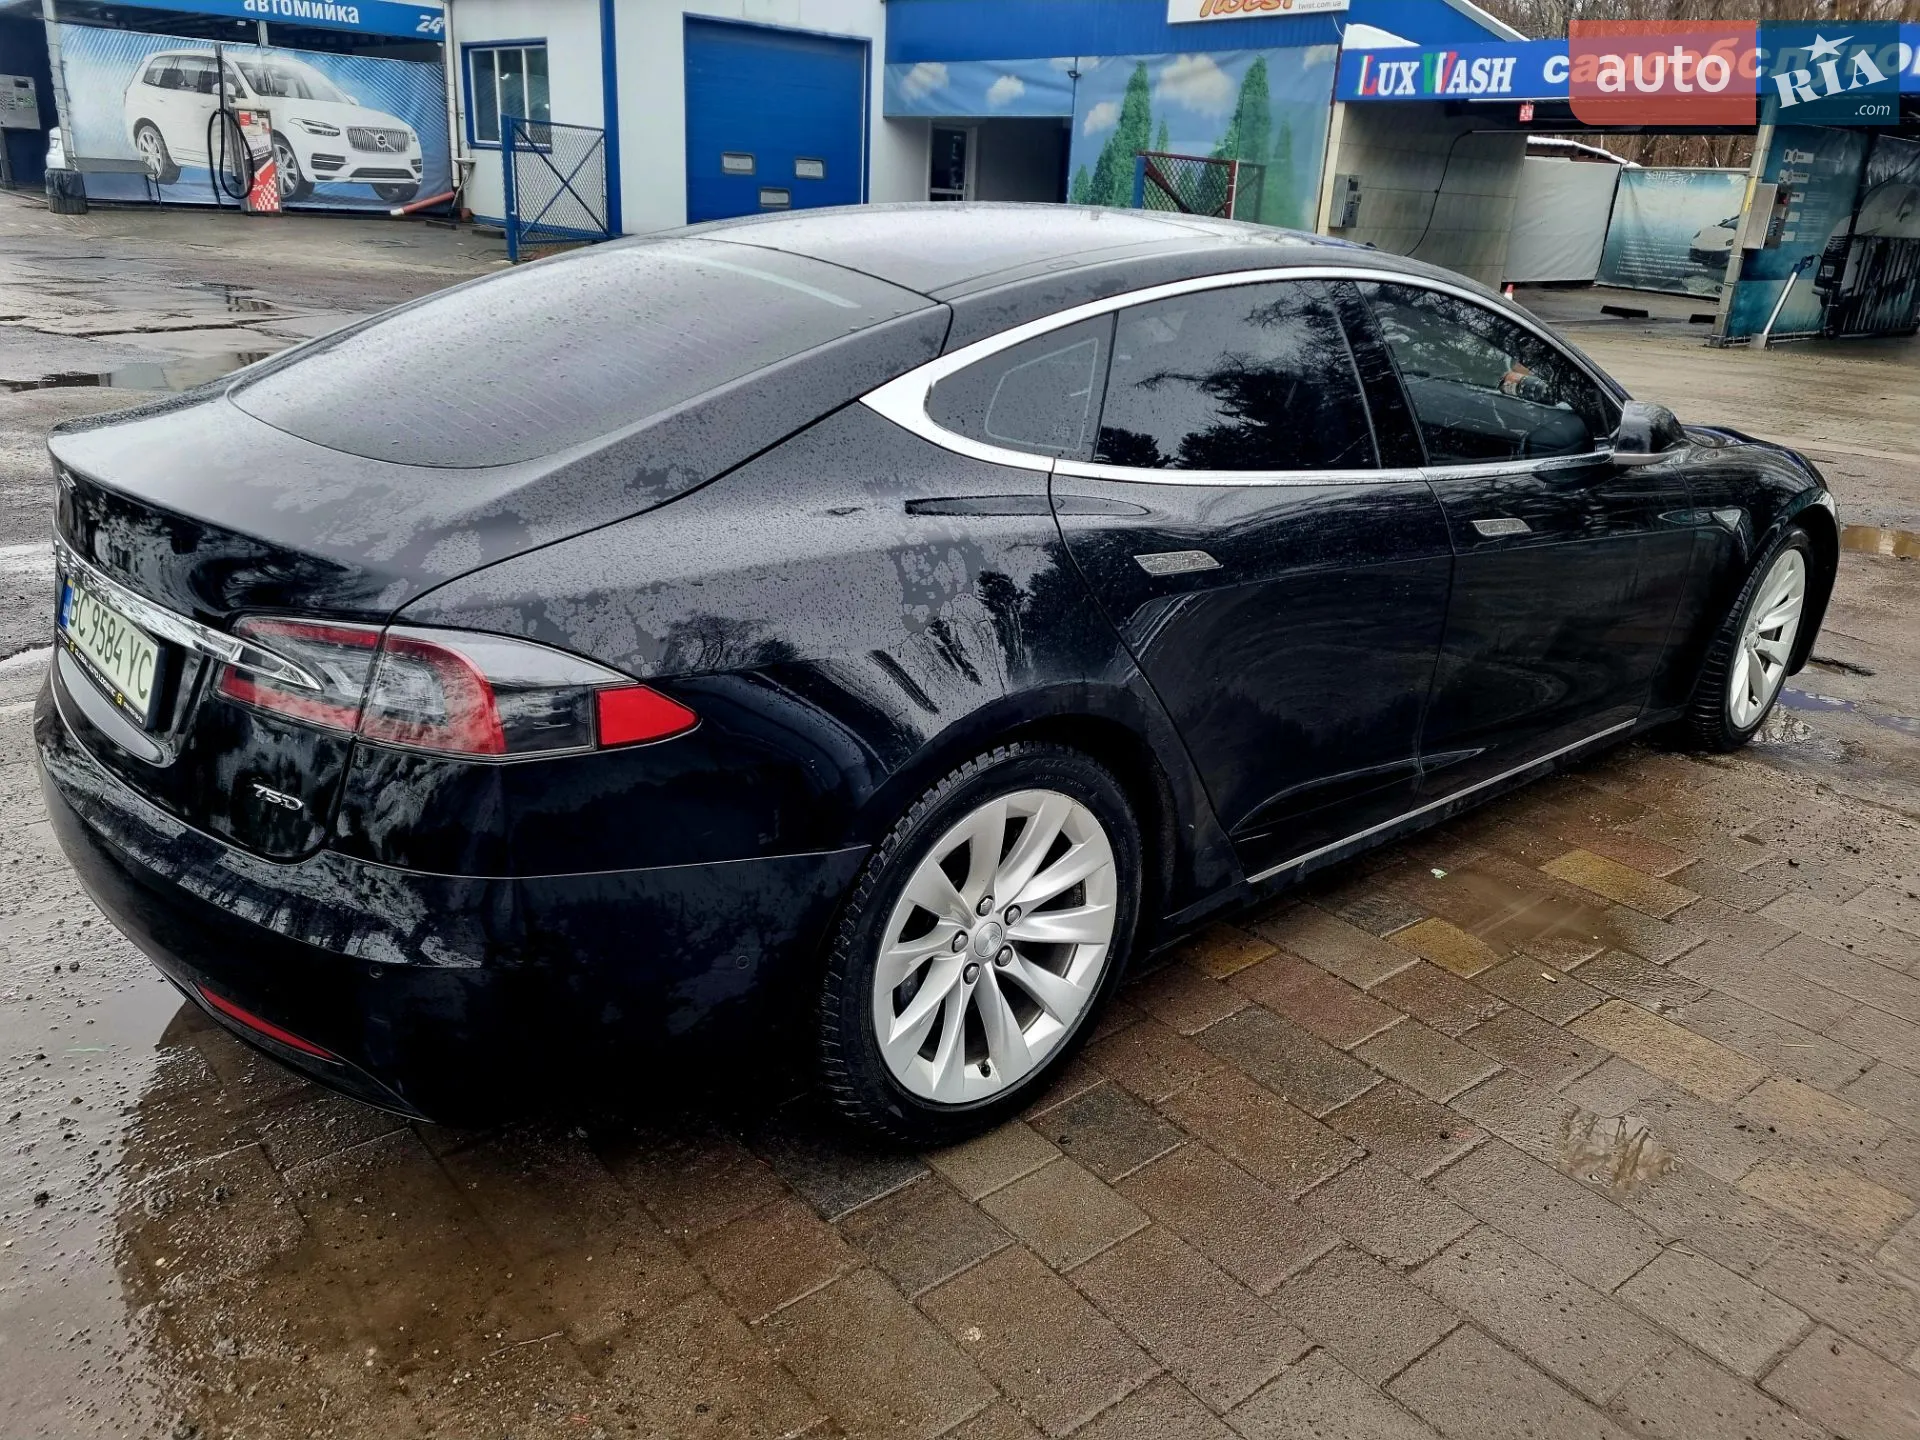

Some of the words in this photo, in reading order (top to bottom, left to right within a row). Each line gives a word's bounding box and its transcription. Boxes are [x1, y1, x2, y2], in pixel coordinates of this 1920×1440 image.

[244, 0, 360, 24] автомийка
[1354, 55, 1420, 96] LUX
[1423, 51, 1517, 94] WASH
[69, 582, 90, 638] BC
[89, 602, 126, 676] 9584
[128, 635, 152, 700] YC
[253, 784, 304, 810] 75D
